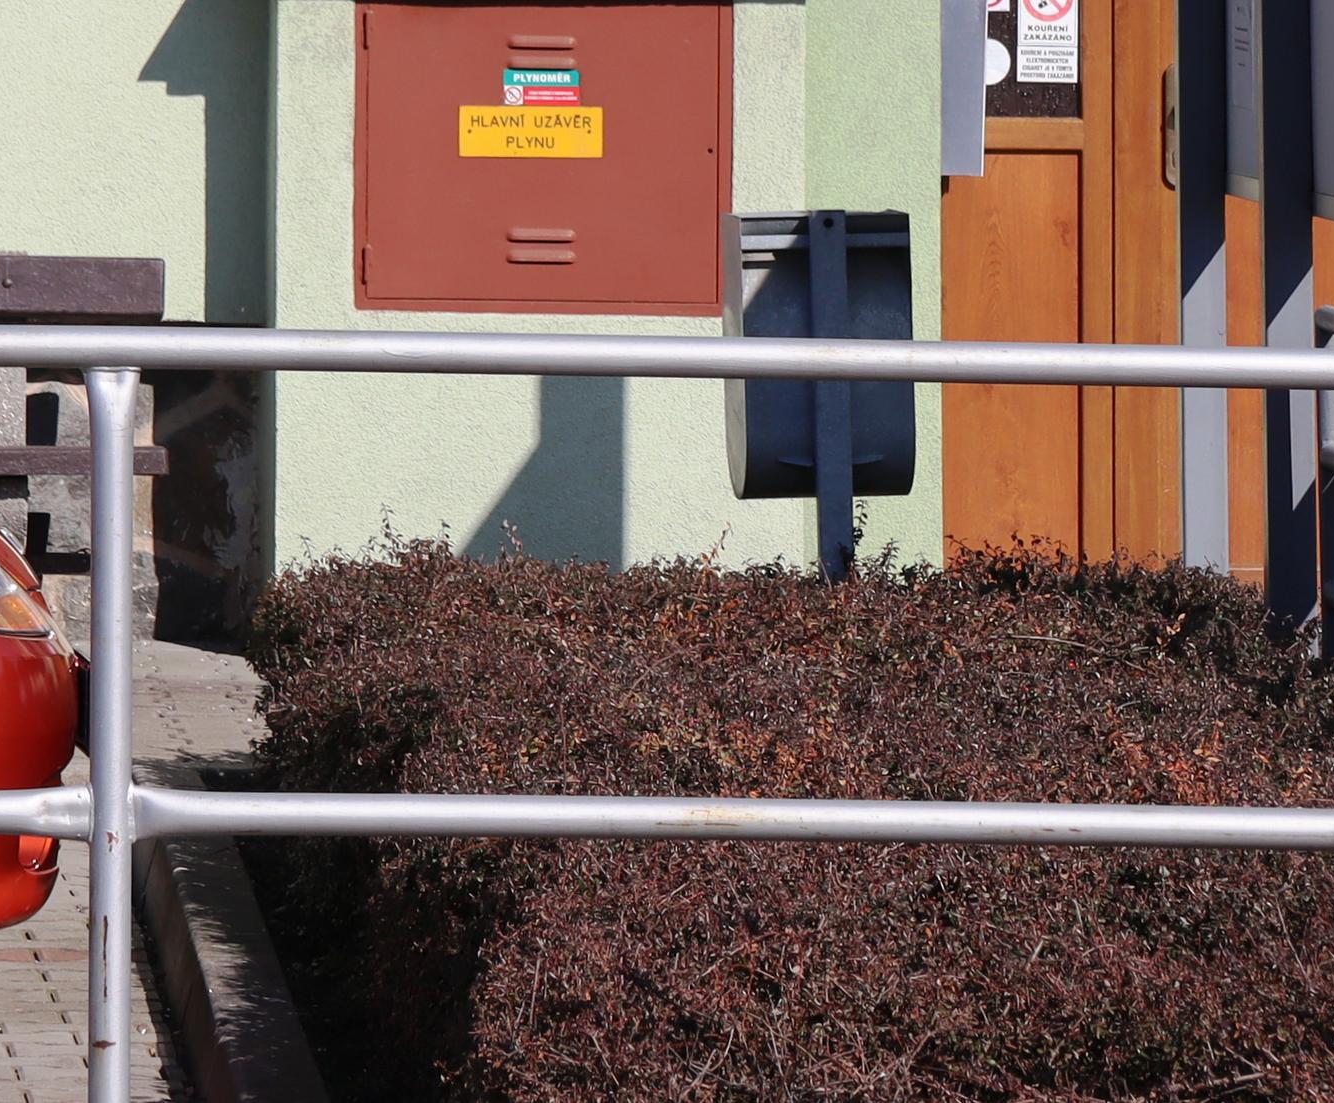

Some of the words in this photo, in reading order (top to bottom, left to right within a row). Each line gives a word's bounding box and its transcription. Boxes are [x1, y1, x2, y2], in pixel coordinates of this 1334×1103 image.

[1027, 24, 1068, 32] KOUŘENÍ
[1023, 33, 1072, 41] ZAKÁZÁNO
[513, 72, 571, 83] PLYNOMĚR
[471, 114, 525, 127] HLAVNÍ
[534, 114, 592, 128] UZÁVĚR
[506, 136, 555, 149] PLYNU
